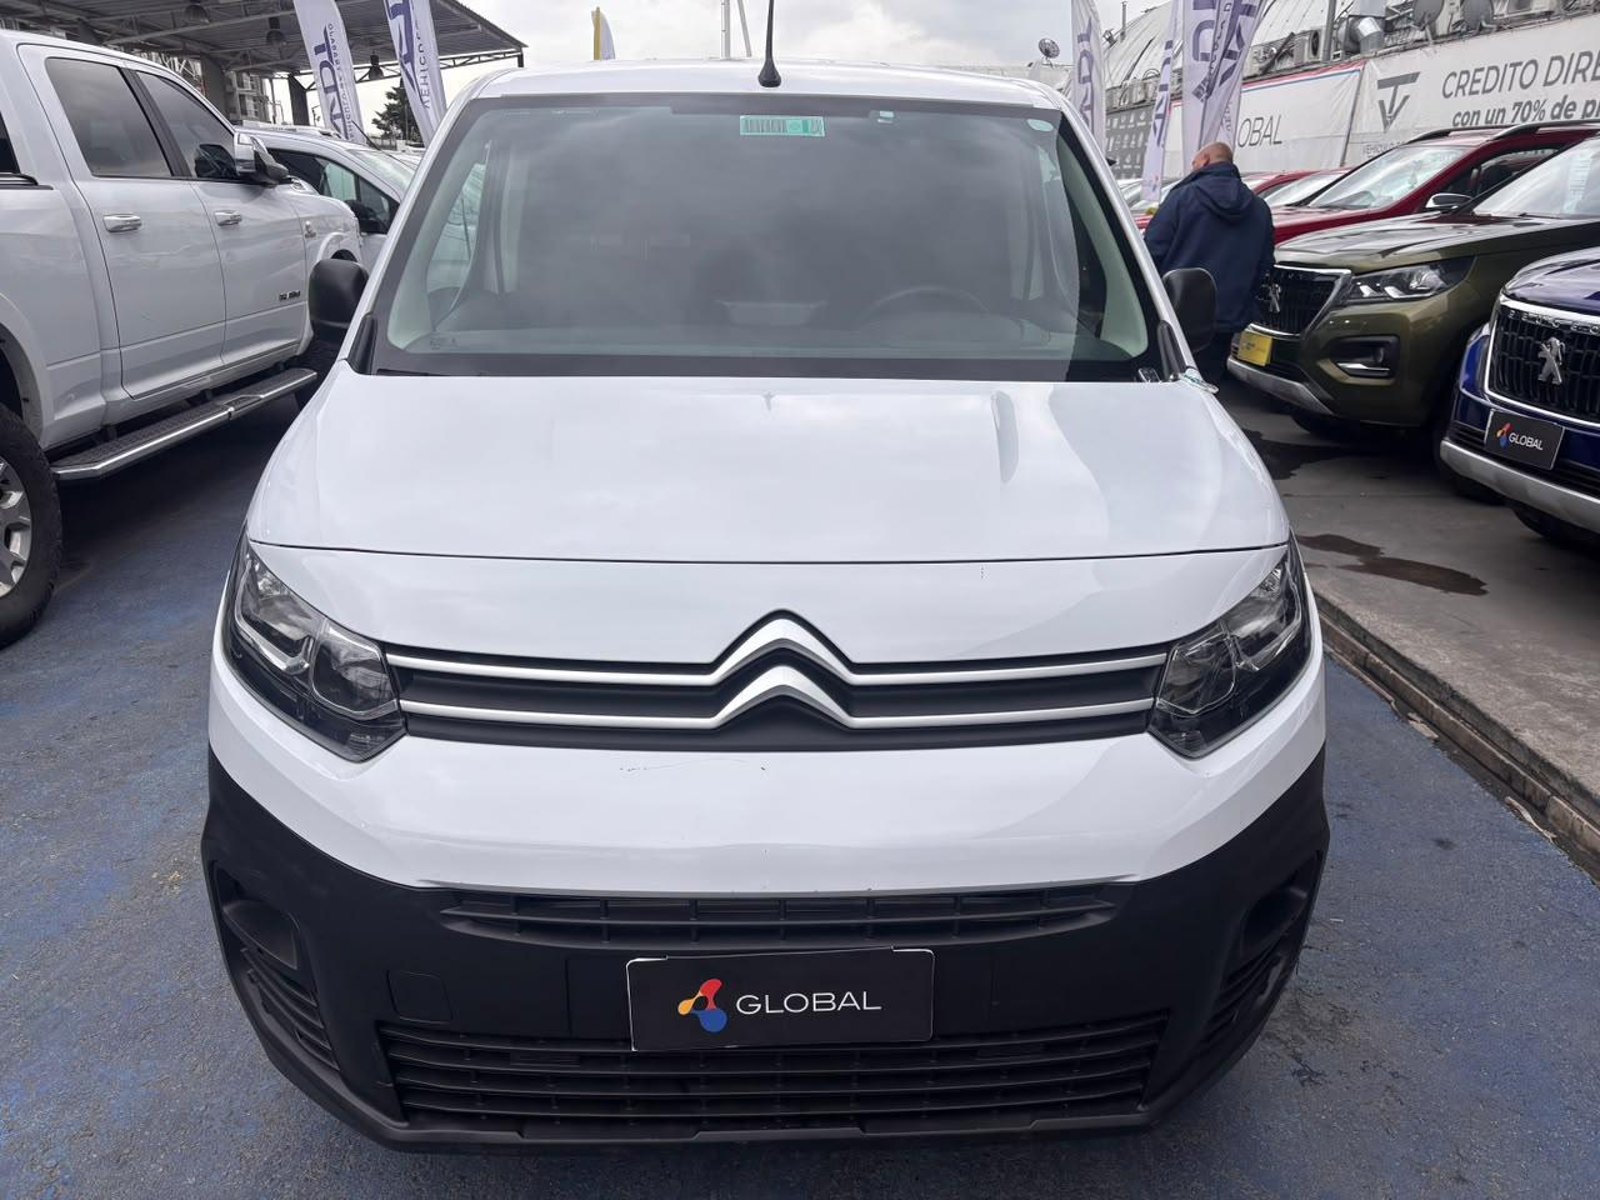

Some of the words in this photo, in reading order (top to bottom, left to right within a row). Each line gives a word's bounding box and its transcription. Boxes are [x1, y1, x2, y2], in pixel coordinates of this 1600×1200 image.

[1442, 58, 1539, 99] CREDITO
[1452, 109, 1481, 128] con
[1484, 106, 1506, 125] un
[1511, 98, 1547, 124] 70%
[1551, 94, 1577, 121] de
[1508, 432, 1544, 451] GLOBAL
[736, 990, 882, 1015] GLOBAL
